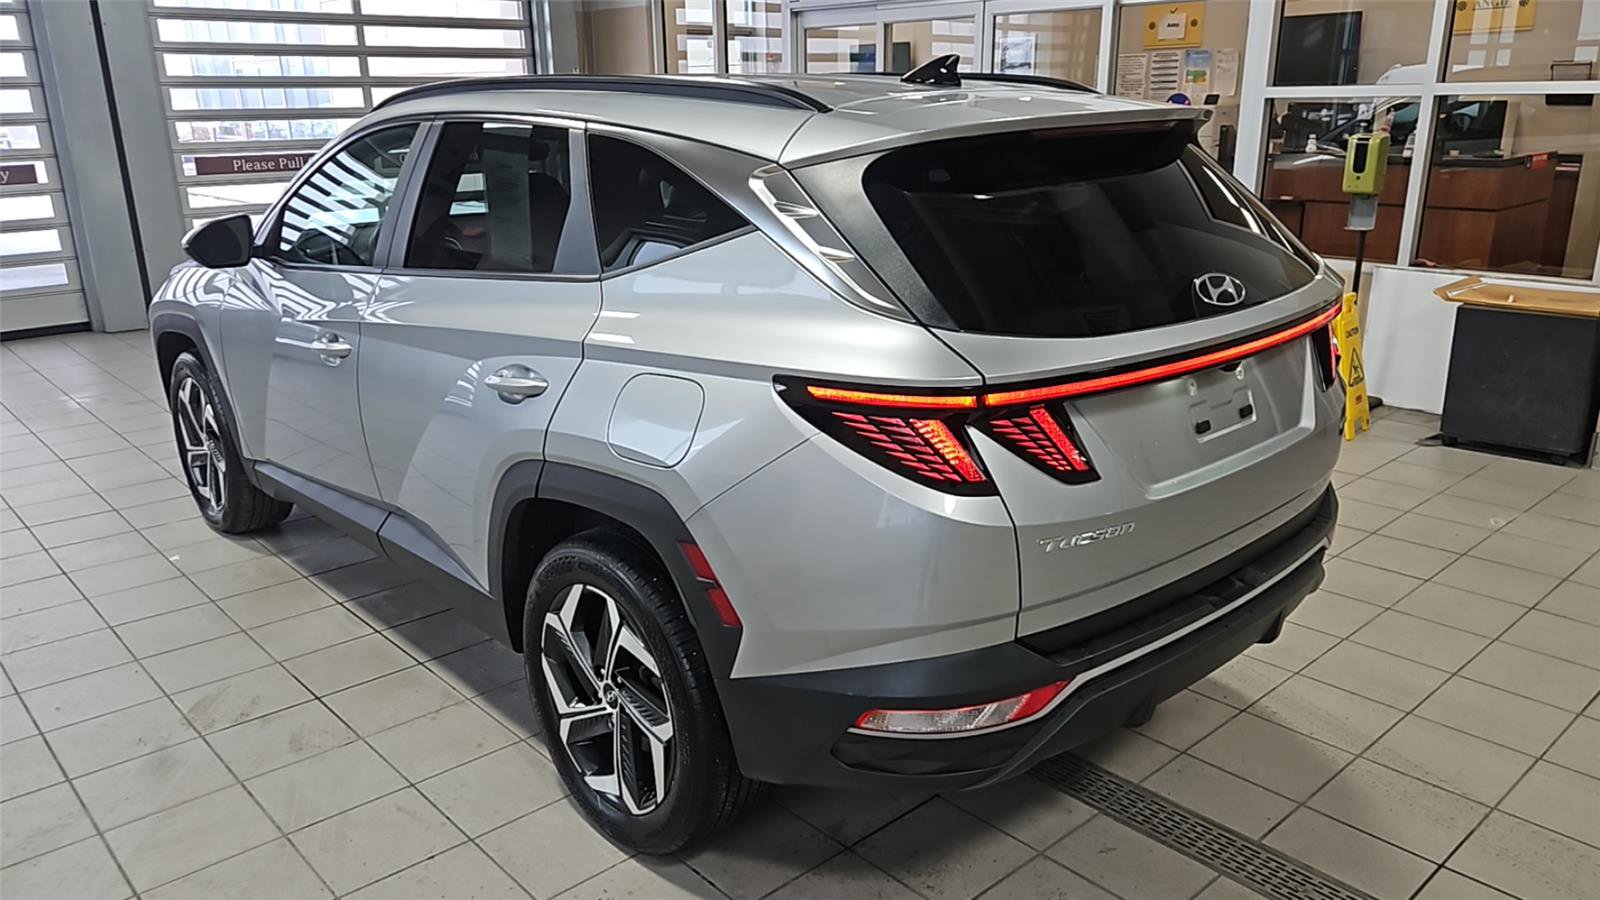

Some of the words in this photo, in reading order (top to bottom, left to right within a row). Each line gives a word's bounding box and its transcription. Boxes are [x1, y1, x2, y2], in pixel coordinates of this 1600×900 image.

[233, 159, 276, 171] Please
[279, 156, 304, 169] Pull
[1036, 521, 1135, 553] TUCSON
